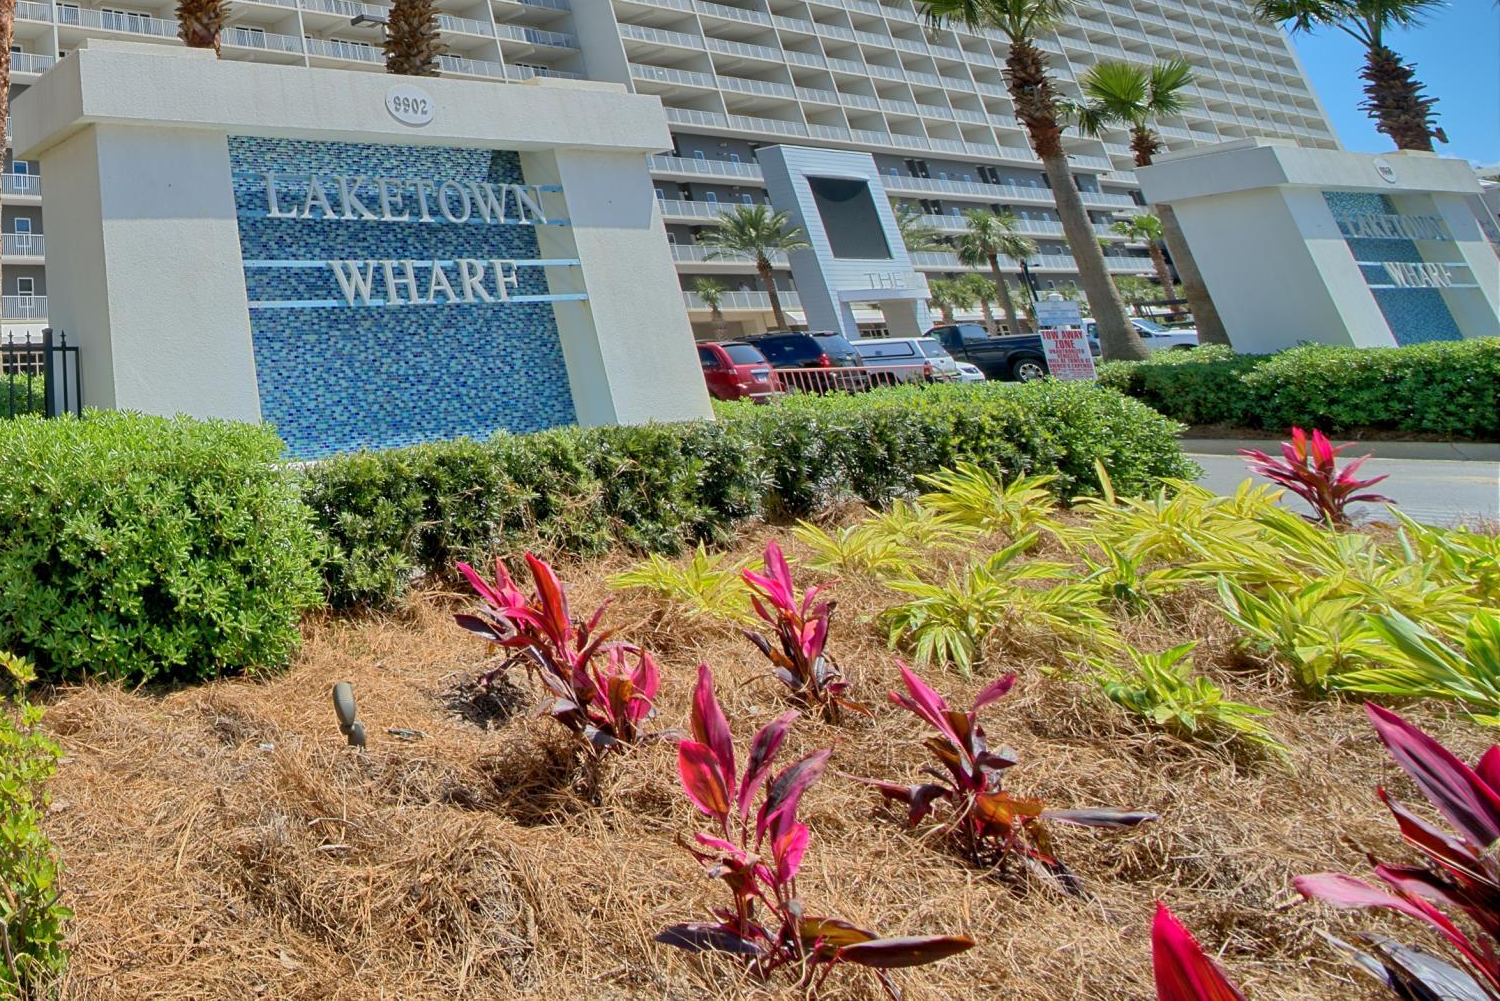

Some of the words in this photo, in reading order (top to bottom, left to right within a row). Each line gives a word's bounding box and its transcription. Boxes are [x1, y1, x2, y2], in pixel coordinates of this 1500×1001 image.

[393, 95, 428, 115] 9902
[260, 171, 547, 225] LAKETOWN
[1343, 213, 1446, 240] LAKETOWN
[327, 258, 518, 306] WHARF
[863, 272, 905, 288] THE
[1382, 261, 1453, 288] WHARF
[1041, 331, 1058, 339] TOW
[1061, 331, 1083, 339] AWAY
[1055, 340, 1075, 349] ZONE
